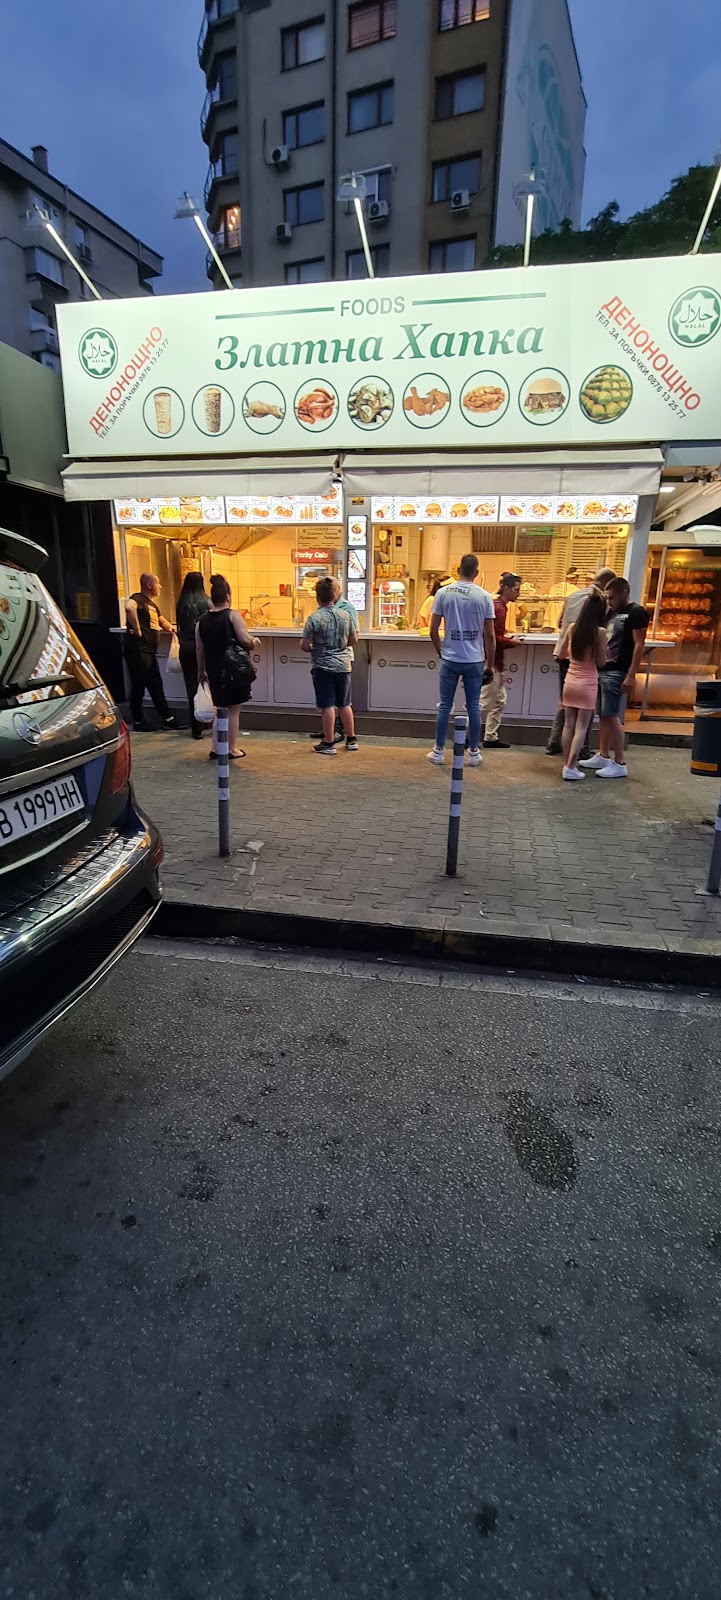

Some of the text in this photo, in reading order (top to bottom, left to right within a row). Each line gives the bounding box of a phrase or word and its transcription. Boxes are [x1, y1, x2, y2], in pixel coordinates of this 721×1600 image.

[340, 296, 405, 317] FOODS
[678, 303, 713, 324] حلال
[86, 342, 111, 359] حلال
[214, 322, 544, 370] Златна Хапка
[595, 310, 687, 419] ТЕЛ. ЗА ПОРЪЧКИ 0876 13 25 77
[600, 295, 701, 410] ДЕНОНОЩНО
[89, 326, 163, 435] ДЕНОНОЩНО
[108, 414, 118, 425] ЗА
[116, 381, 141, 415] ПОРЪЧКИ
[138, 366, 151, 382] 0876
[150, 356, 158, 366] 13
[156, 347, 164, 357] 25
[162, 338, 170, 348] 77
[13, 789, 57, 829] 1999
[54, 780, 81, 811] HH
